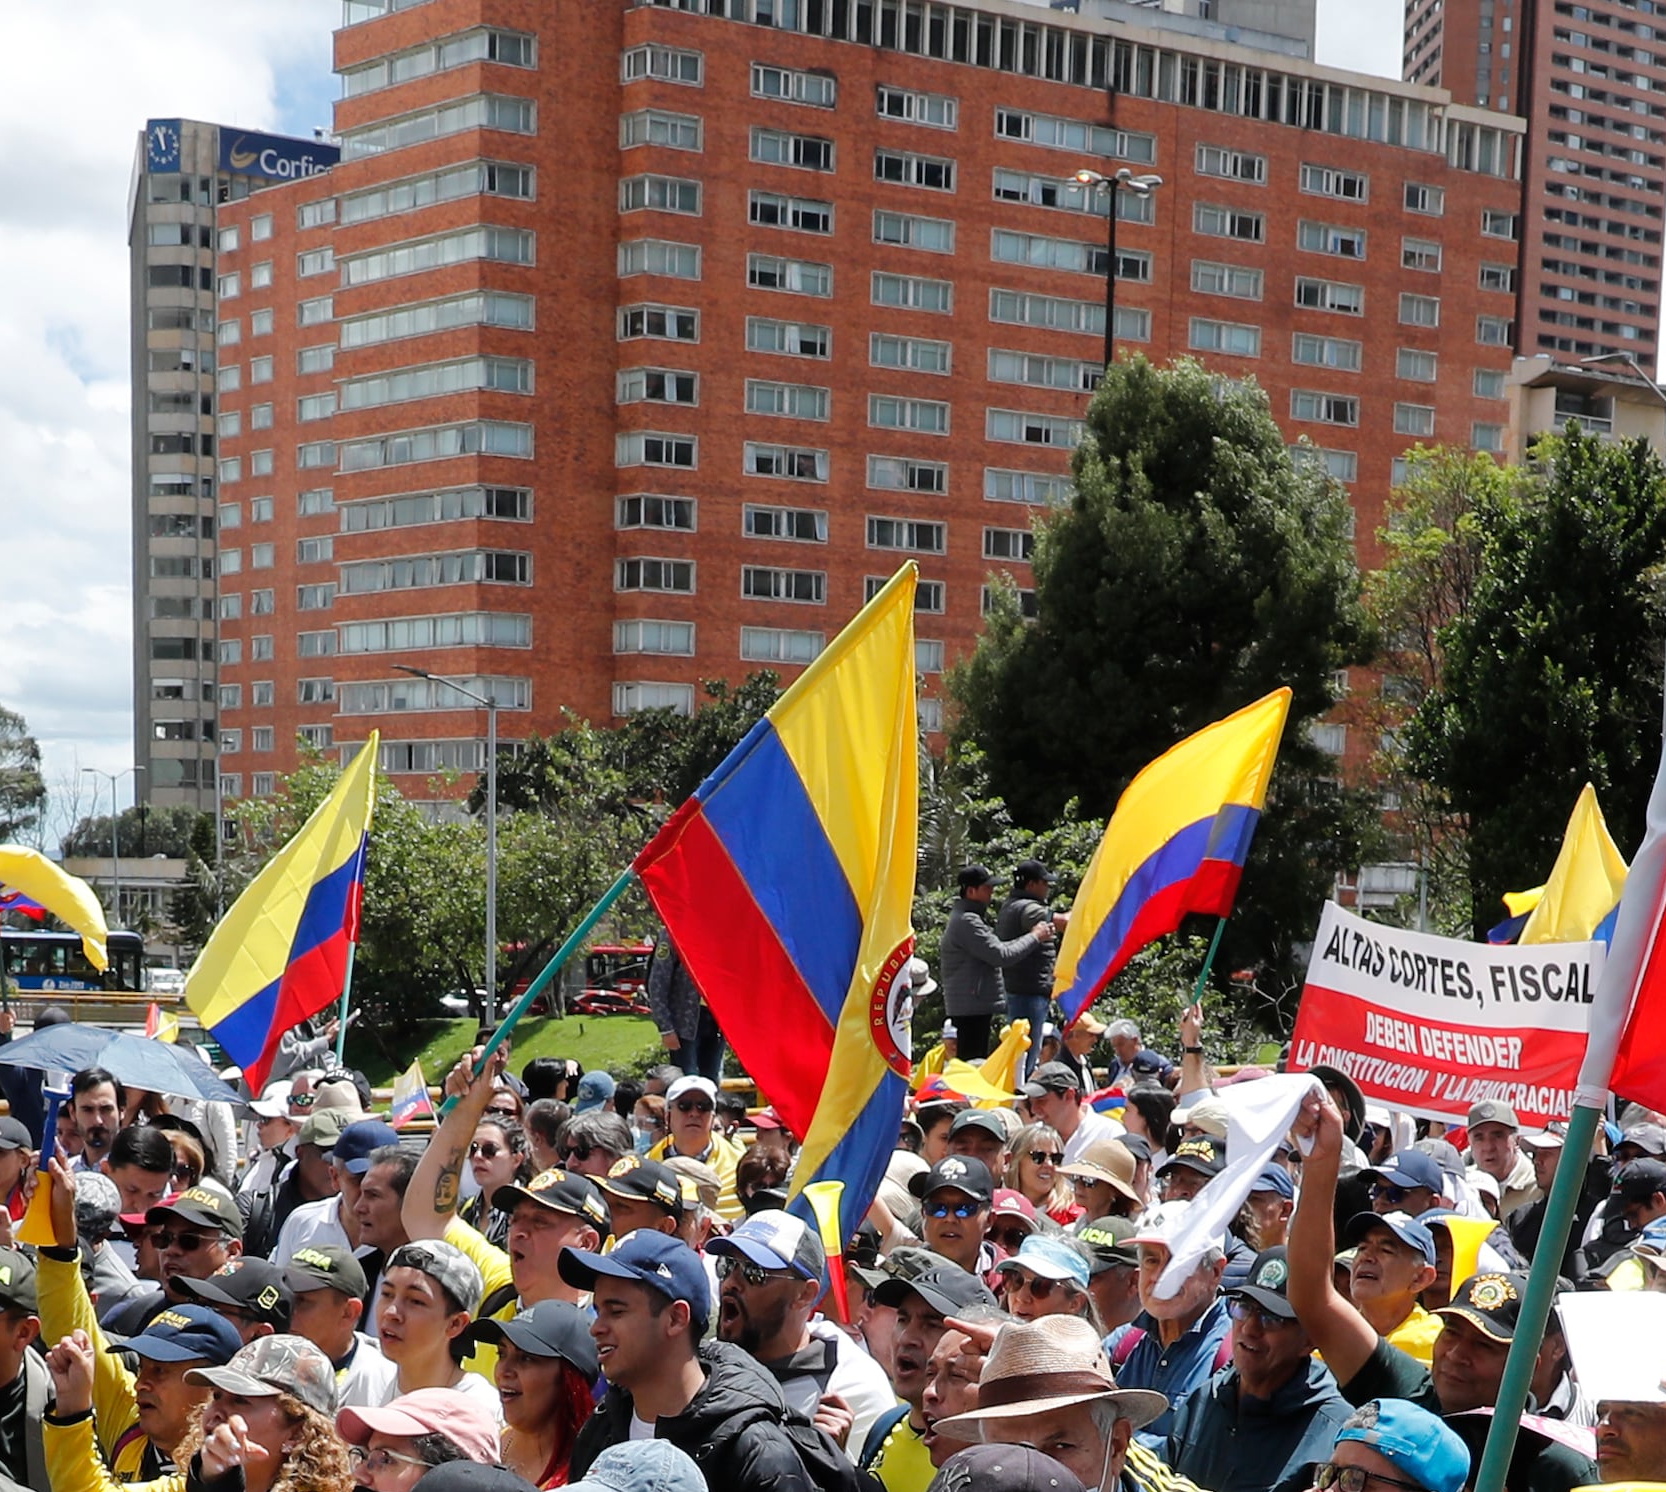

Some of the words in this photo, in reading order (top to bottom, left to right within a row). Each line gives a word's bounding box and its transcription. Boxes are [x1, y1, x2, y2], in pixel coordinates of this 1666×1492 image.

[1322, 924, 1383, 977] ALTAS
[1389, 946, 1485, 1009] CORTES,
[1490, 962, 1595, 1004] FISCAL
[1295, 1039, 1315, 1066] LA
[1316, 1047, 1429, 1094] CONSTITUCION
[1432, 1071, 1450, 1098] Y
[1442, 1075, 1468, 1101] LA
[1364, 1011, 1417, 1055] DEBEN
[1419, 1025, 1524, 1070] DEFENDER
